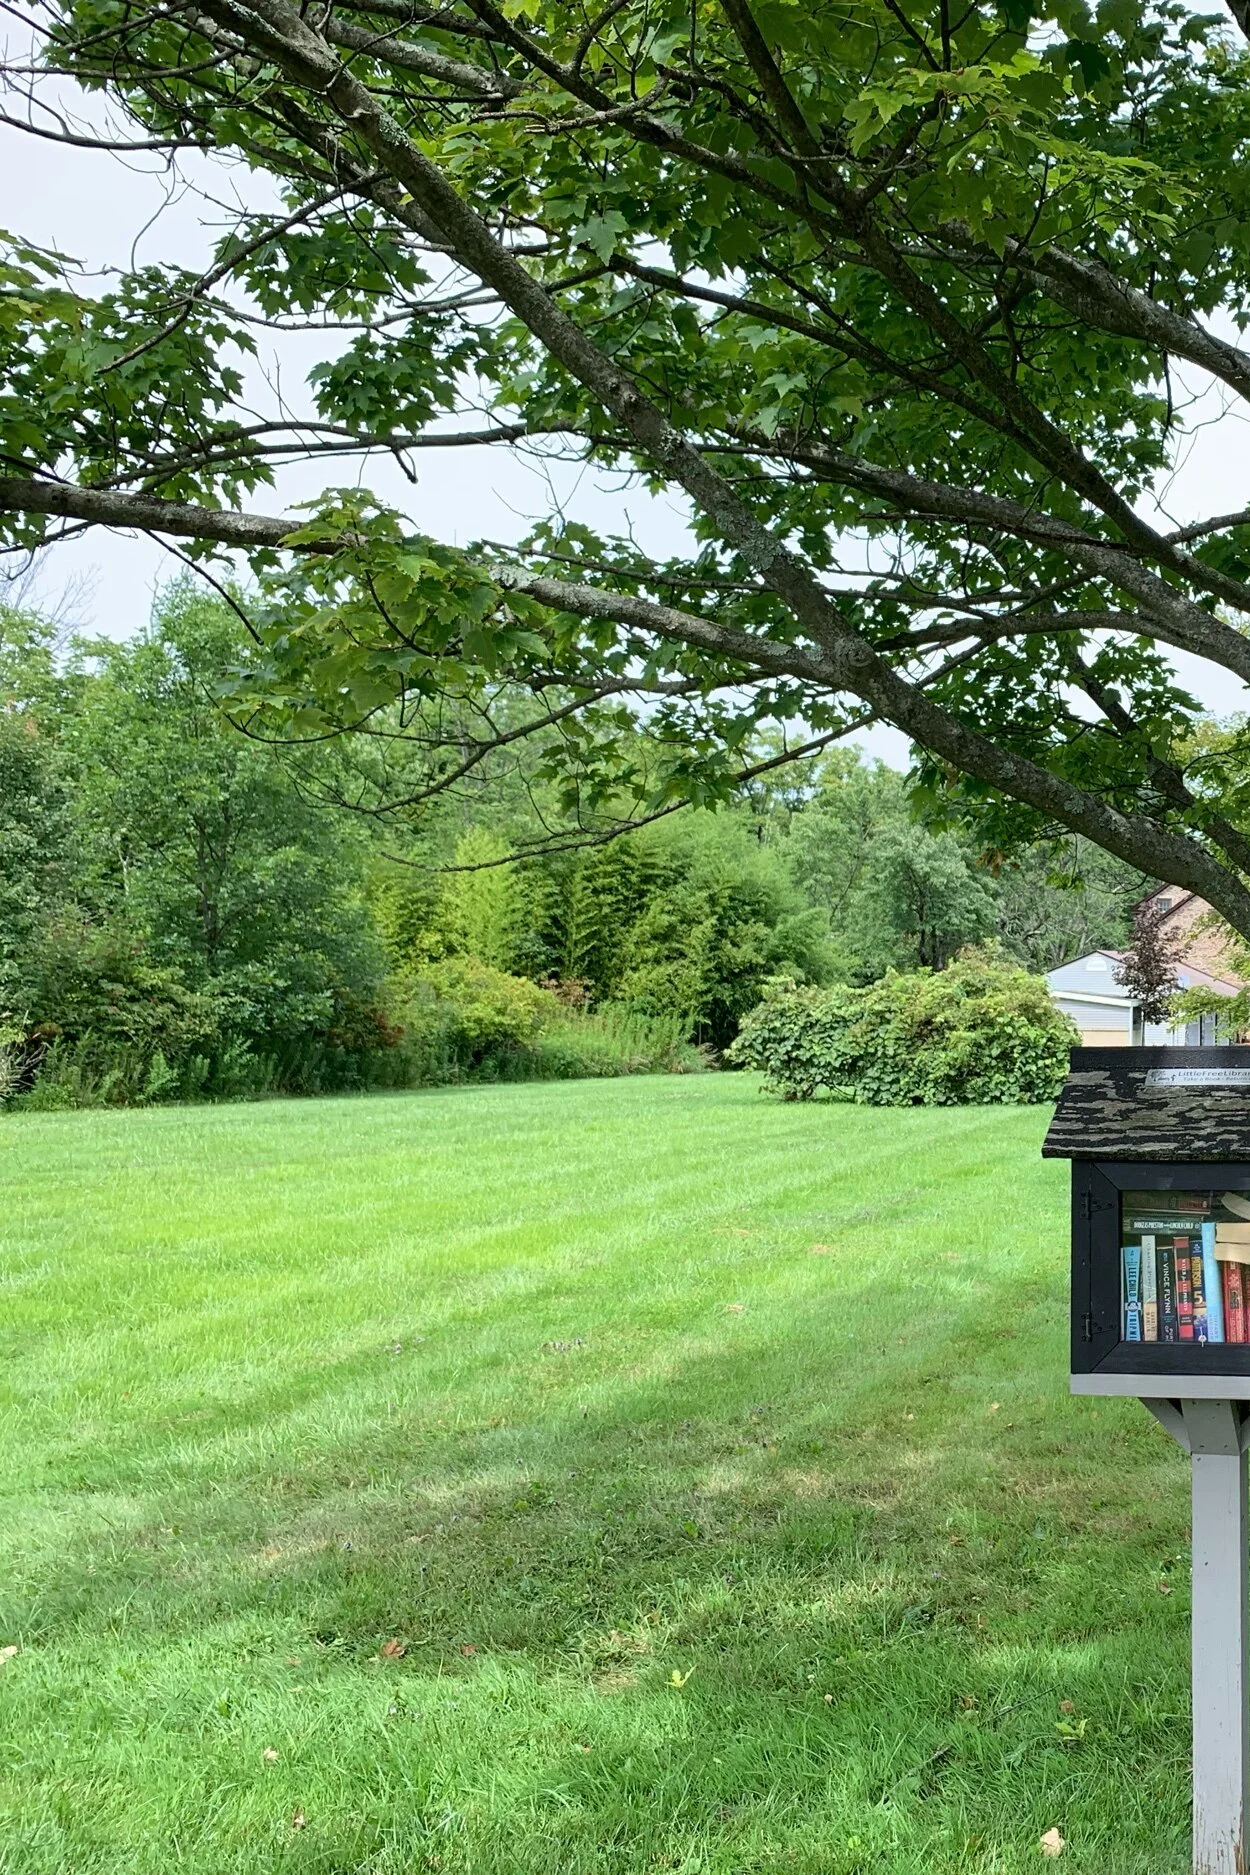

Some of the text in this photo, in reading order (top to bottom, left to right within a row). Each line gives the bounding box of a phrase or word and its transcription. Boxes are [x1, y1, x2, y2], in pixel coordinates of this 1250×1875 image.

[1129, 1267, 1137, 1279] LEE
[1191, 1256, 1201, 1287] PATTERSON
[1129, 1279, 1137, 1298] CHILD
[1163, 1288, 1171, 1314] FLYNN
